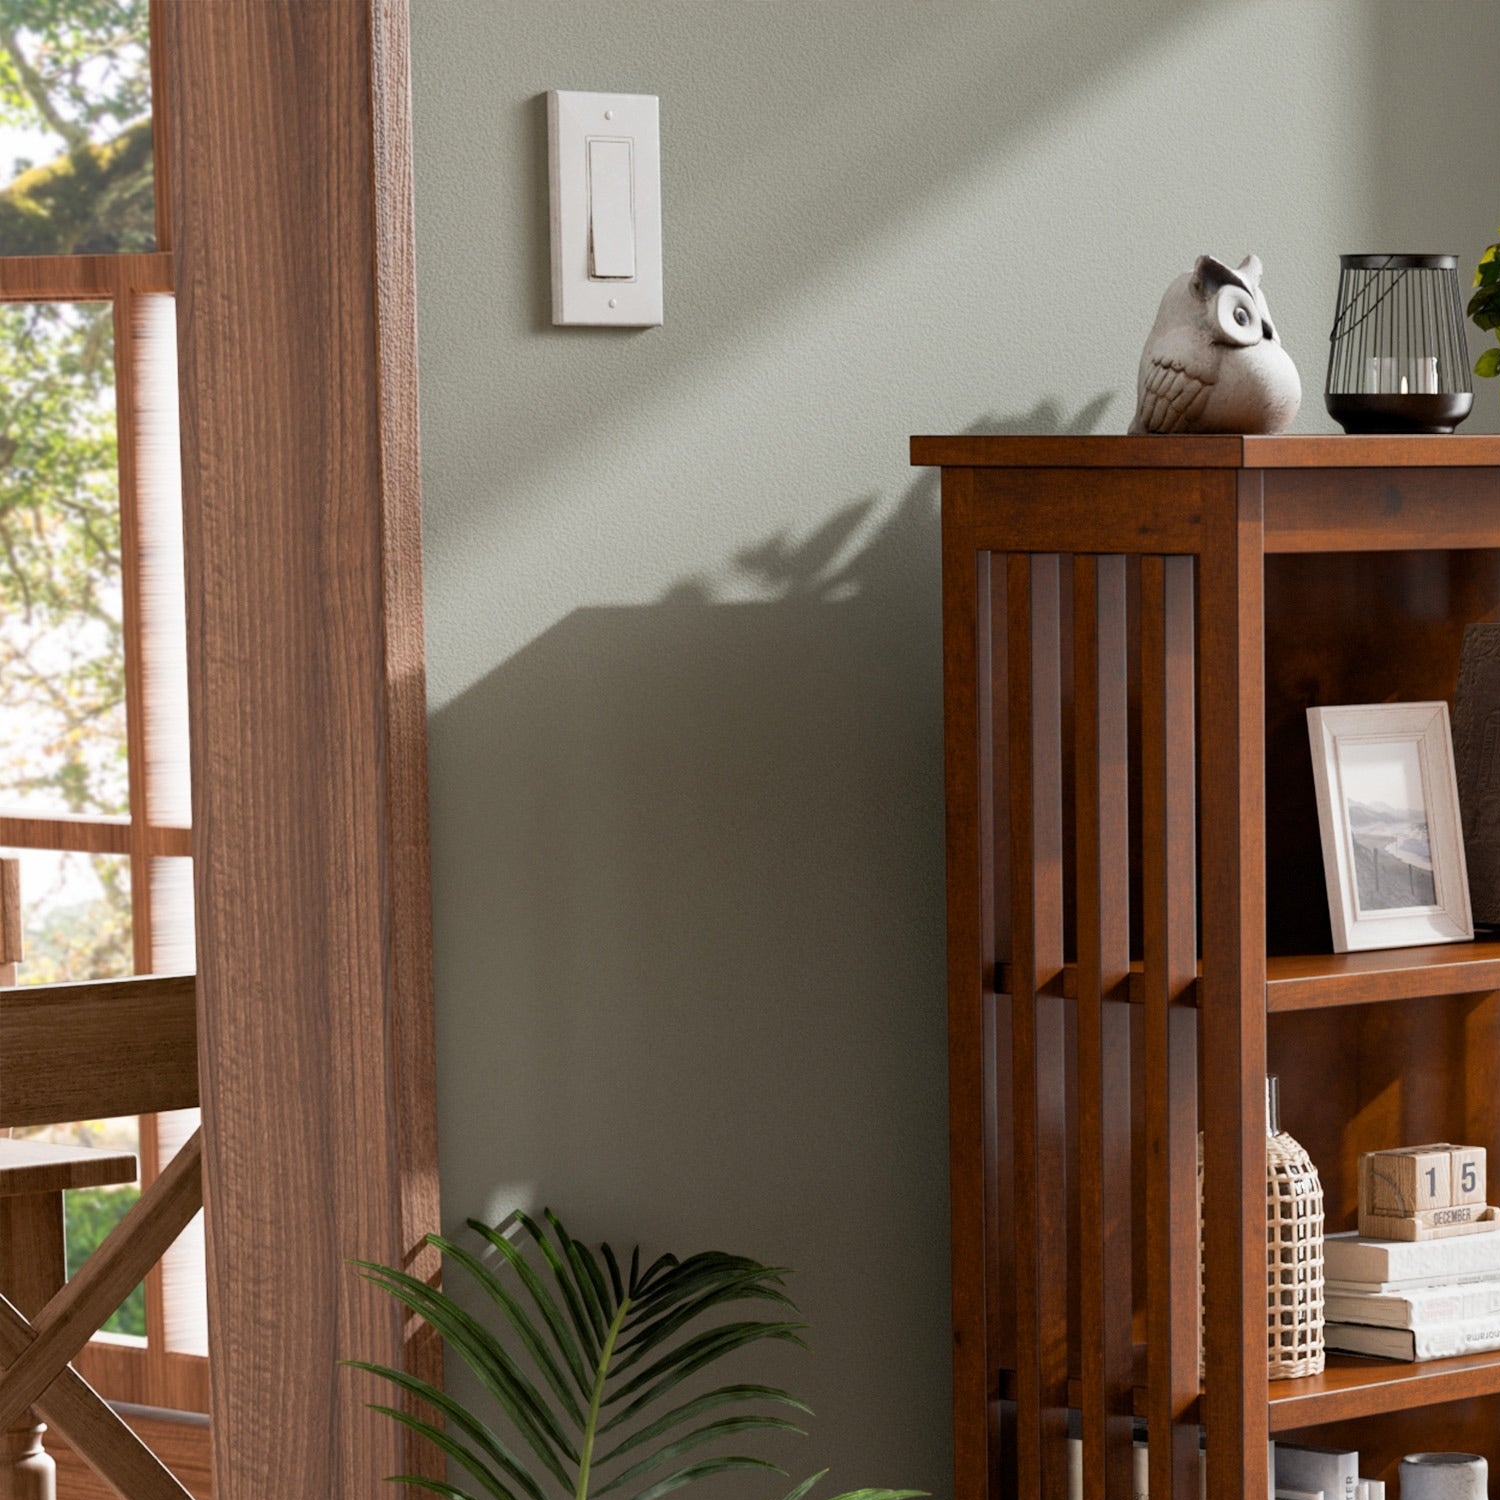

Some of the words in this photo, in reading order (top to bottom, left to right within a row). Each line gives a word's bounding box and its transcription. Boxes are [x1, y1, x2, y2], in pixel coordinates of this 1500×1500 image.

[1425, 1167, 1436, 1197] 1
[1461, 1162, 1476, 1193] 5
[1433, 1208, 1471, 1225] DECEMBER
